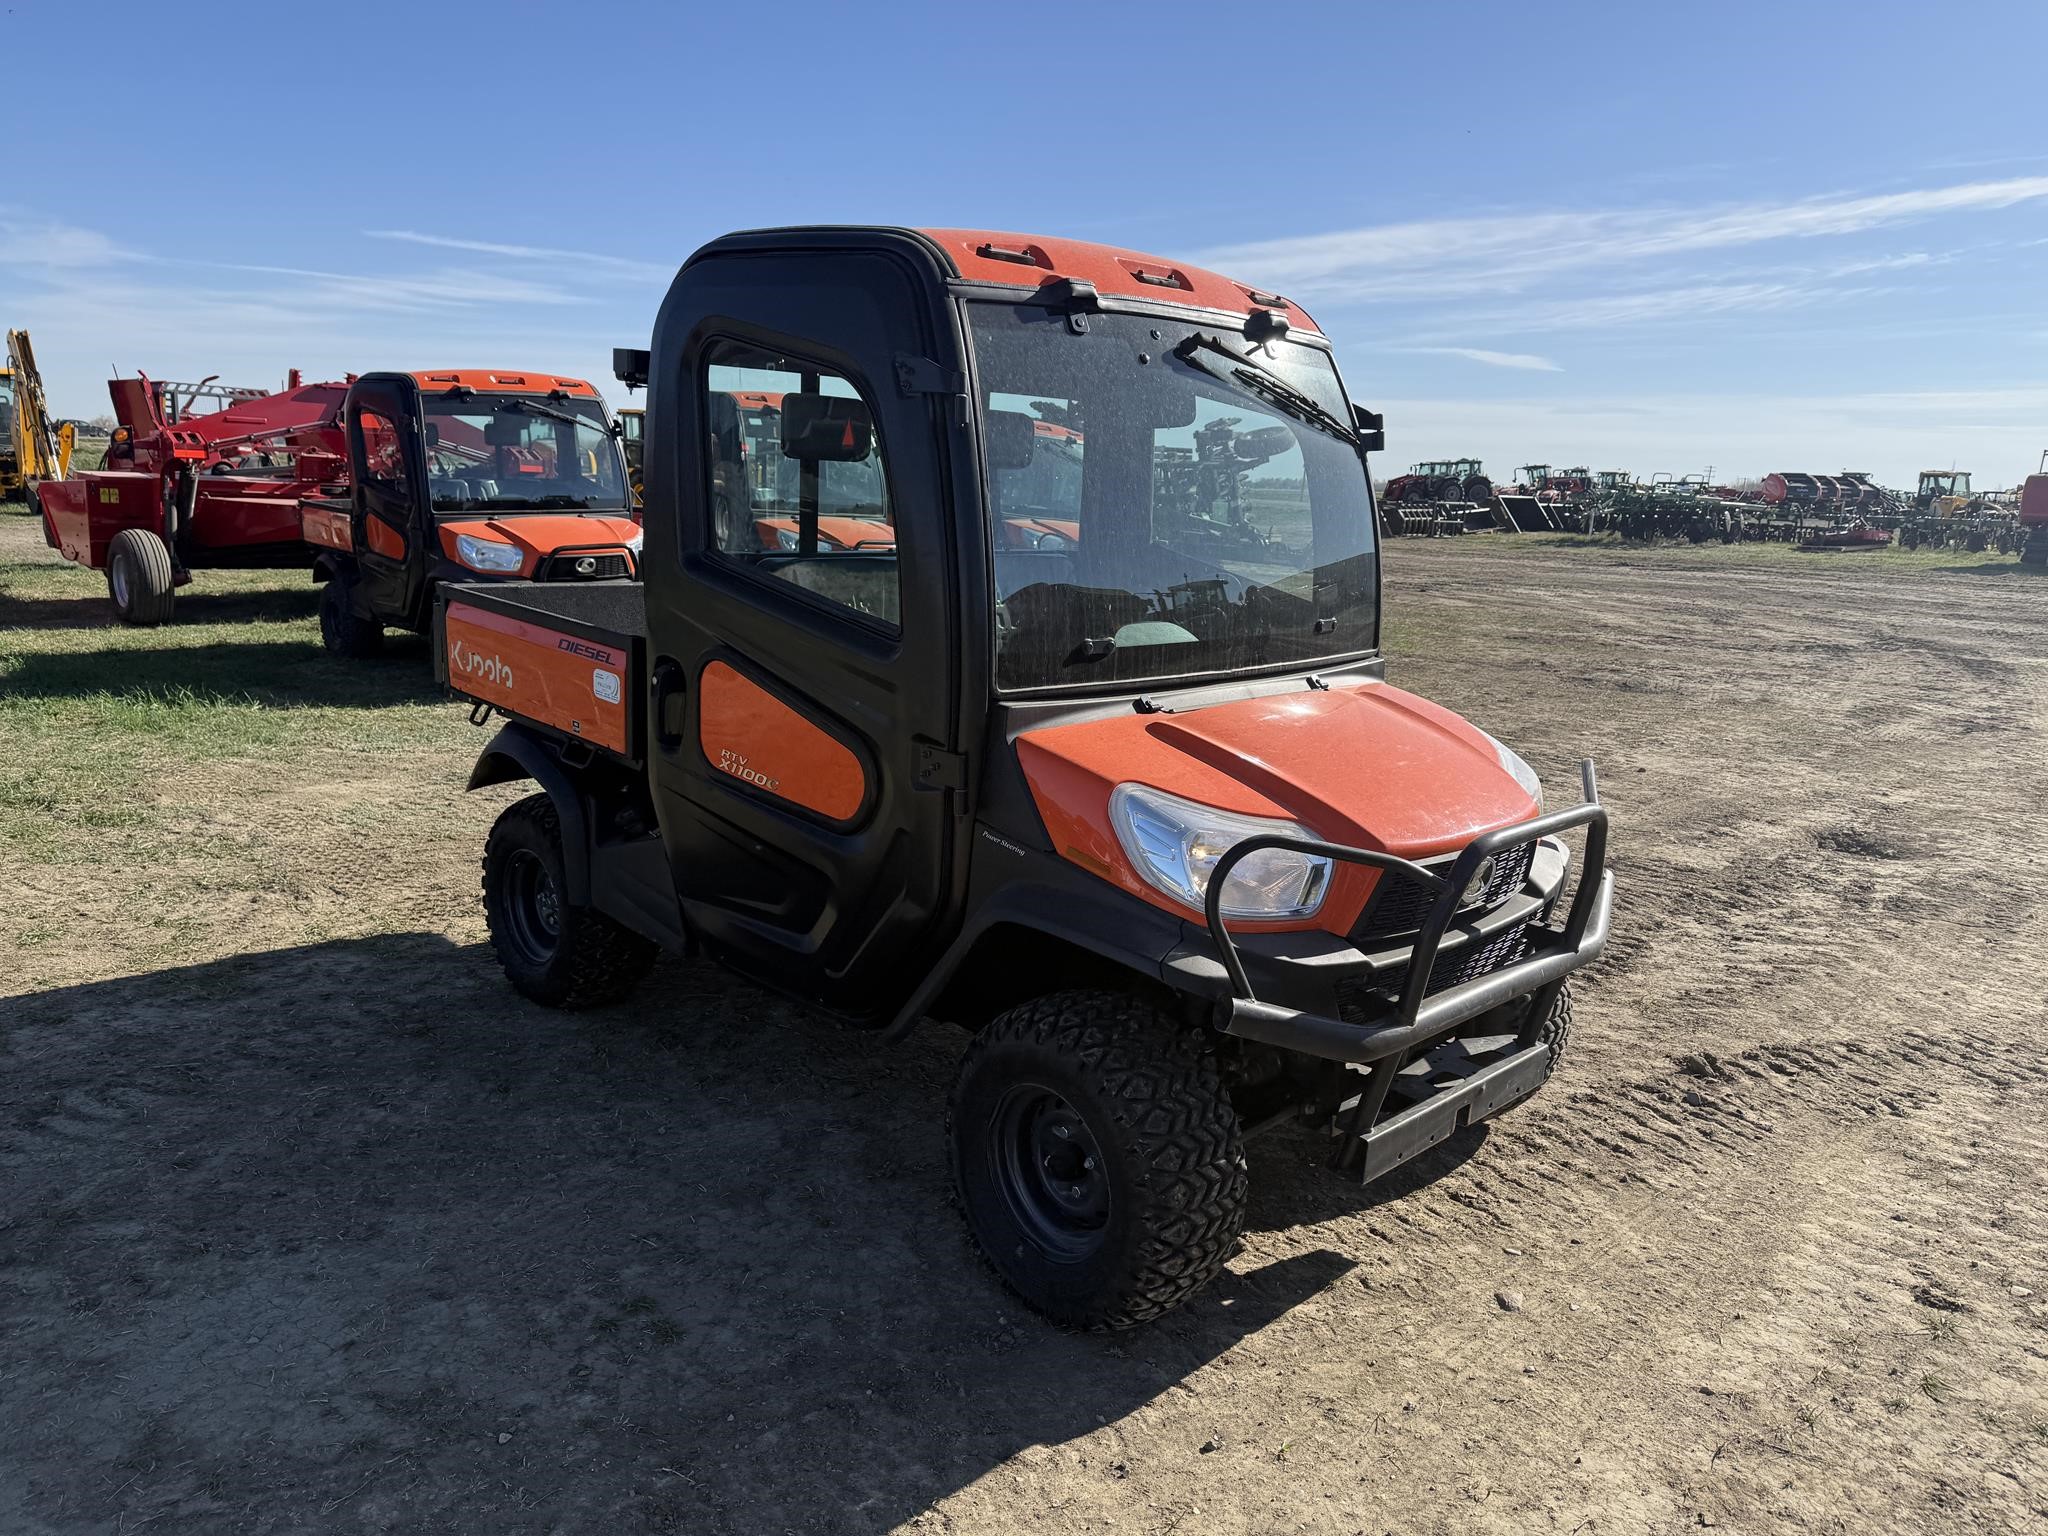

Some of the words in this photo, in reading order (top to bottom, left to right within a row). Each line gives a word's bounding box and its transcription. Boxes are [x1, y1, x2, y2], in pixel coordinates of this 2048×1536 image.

[450, 639, 513, 689] Kubota
[558, 638, 616, 666] DIESEL
[721, 749, 749, 765] RTV
[982, 830, 1001, 843] Power
[1000, 839, 1026, 857] Steering
